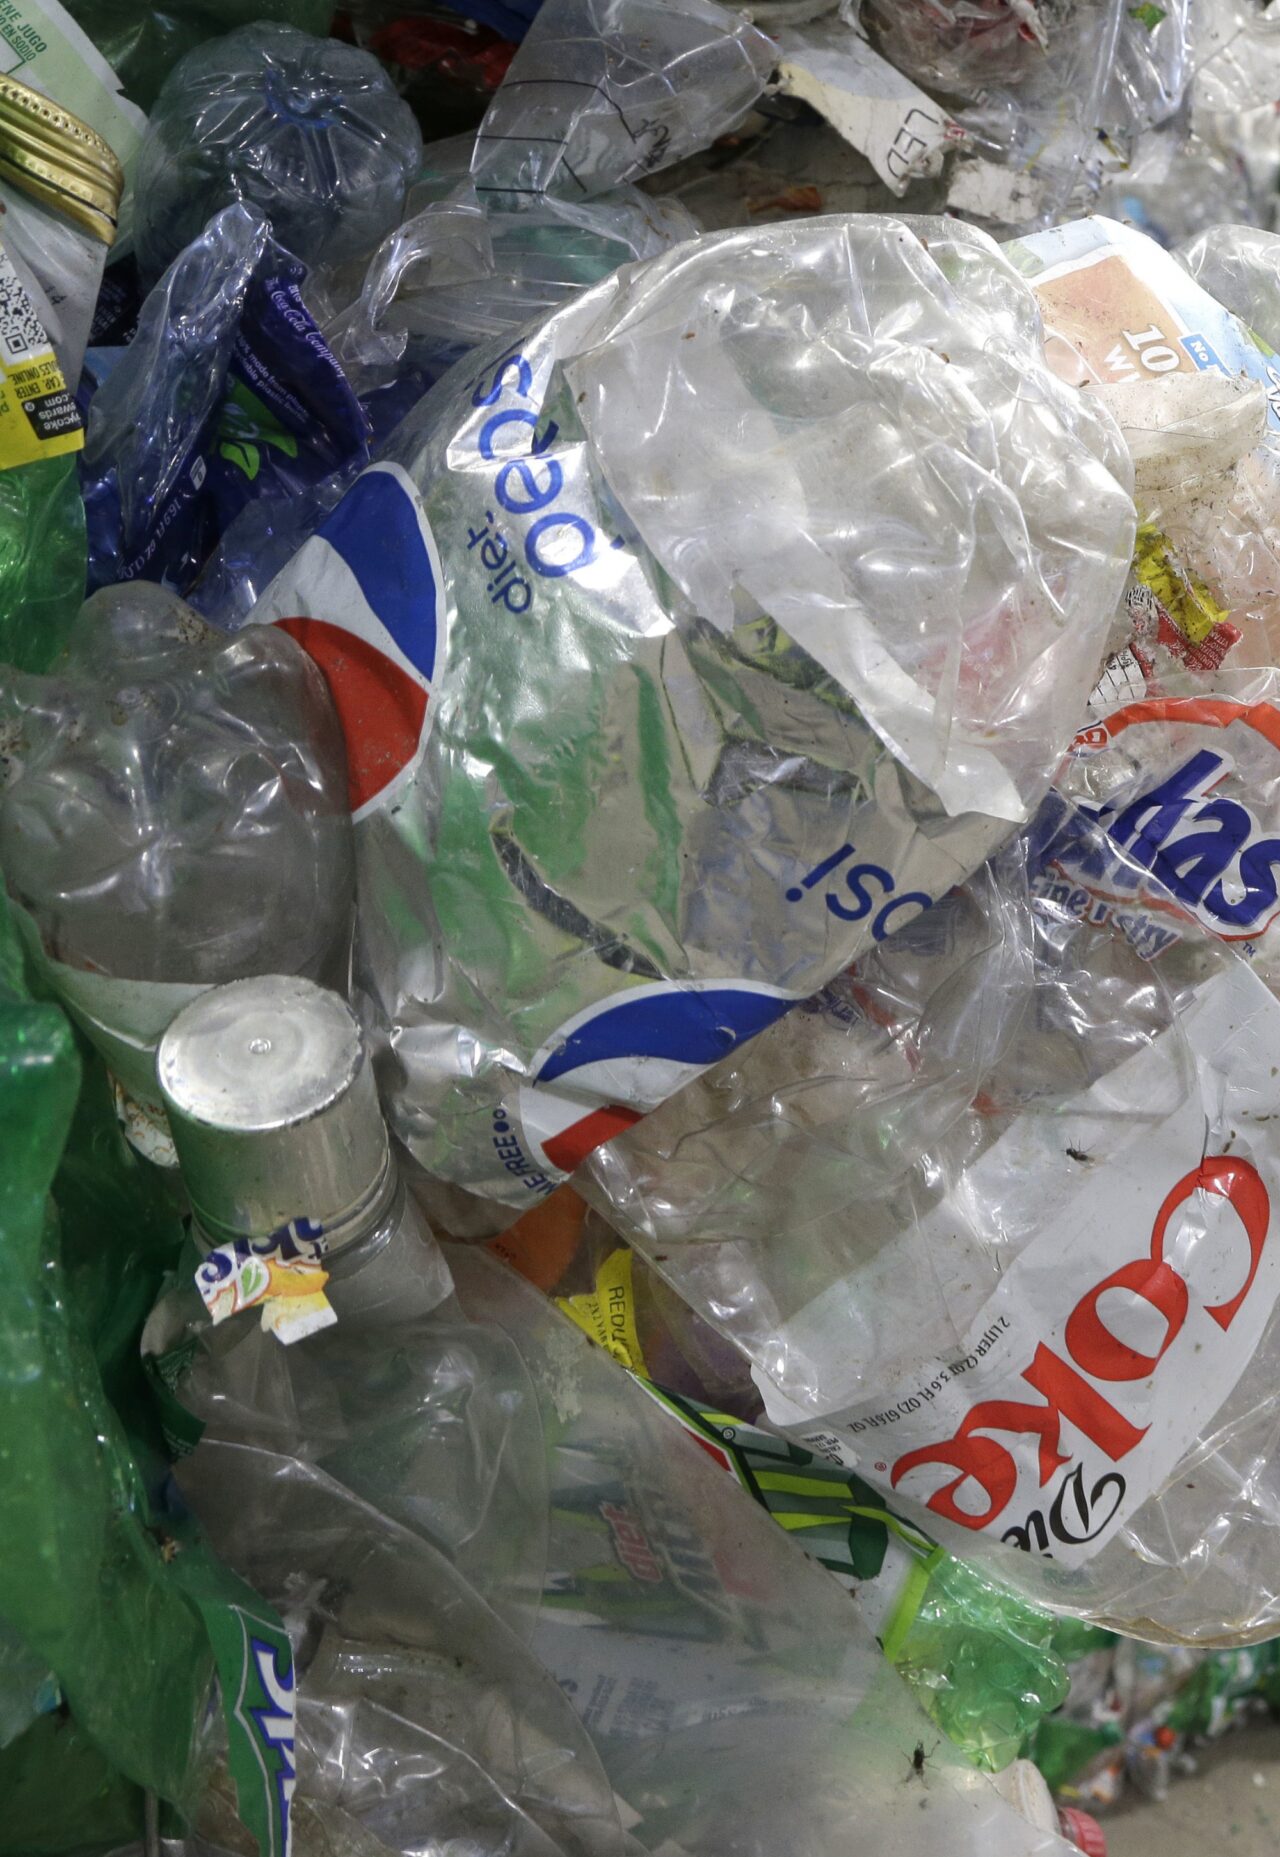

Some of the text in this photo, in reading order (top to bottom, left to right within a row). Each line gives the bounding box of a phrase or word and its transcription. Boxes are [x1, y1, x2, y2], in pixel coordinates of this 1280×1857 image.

[2, 24, 17, 38] EN
[12, 35, 36, 61] SODIO
[17, 24, 47, 53] JUGO
[305, 330, 346, 378] Company
[1121, 324, 1181, 372] 10
[249, 351, 270, 379] made
[15, 381, 42, 399] ENTER
[493, 1134, 537, 1177] FREE
[999, 1316, 1011, 1329] 2
[890, 1155, 1271, 1532] Coke
[978, 1325, 1005, 1357] LITER
[916, 1387, 935, 1402] FL
[931, 1370, 951, 1391] 3.6
[880, 1408, 901, 1426] 67.6
[896, 1398, 921, 1415] OZ)
[848, 1420, 866, 1434] OZ
[999, 1462, 1127, 1556] Die
